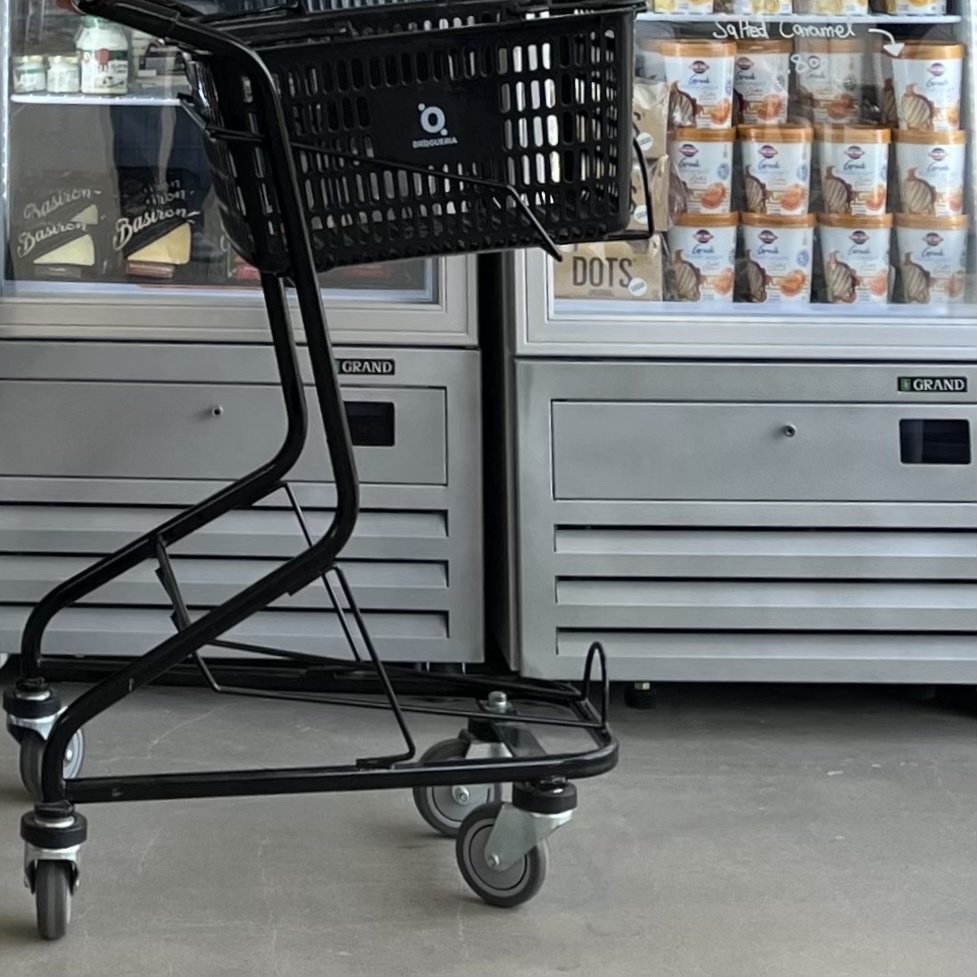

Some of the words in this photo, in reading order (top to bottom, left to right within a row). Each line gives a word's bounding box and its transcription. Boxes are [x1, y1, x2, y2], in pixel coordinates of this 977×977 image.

[713, 20, 769, 40] Salted
[778, 21, 856, 39] Caramel
[113, 207, 188, 252] Basiron
[572, 255, 633, 288] DOTS
[341, 360, 394, 374] GRAND
[912, 378, 966, 392] GRAND
